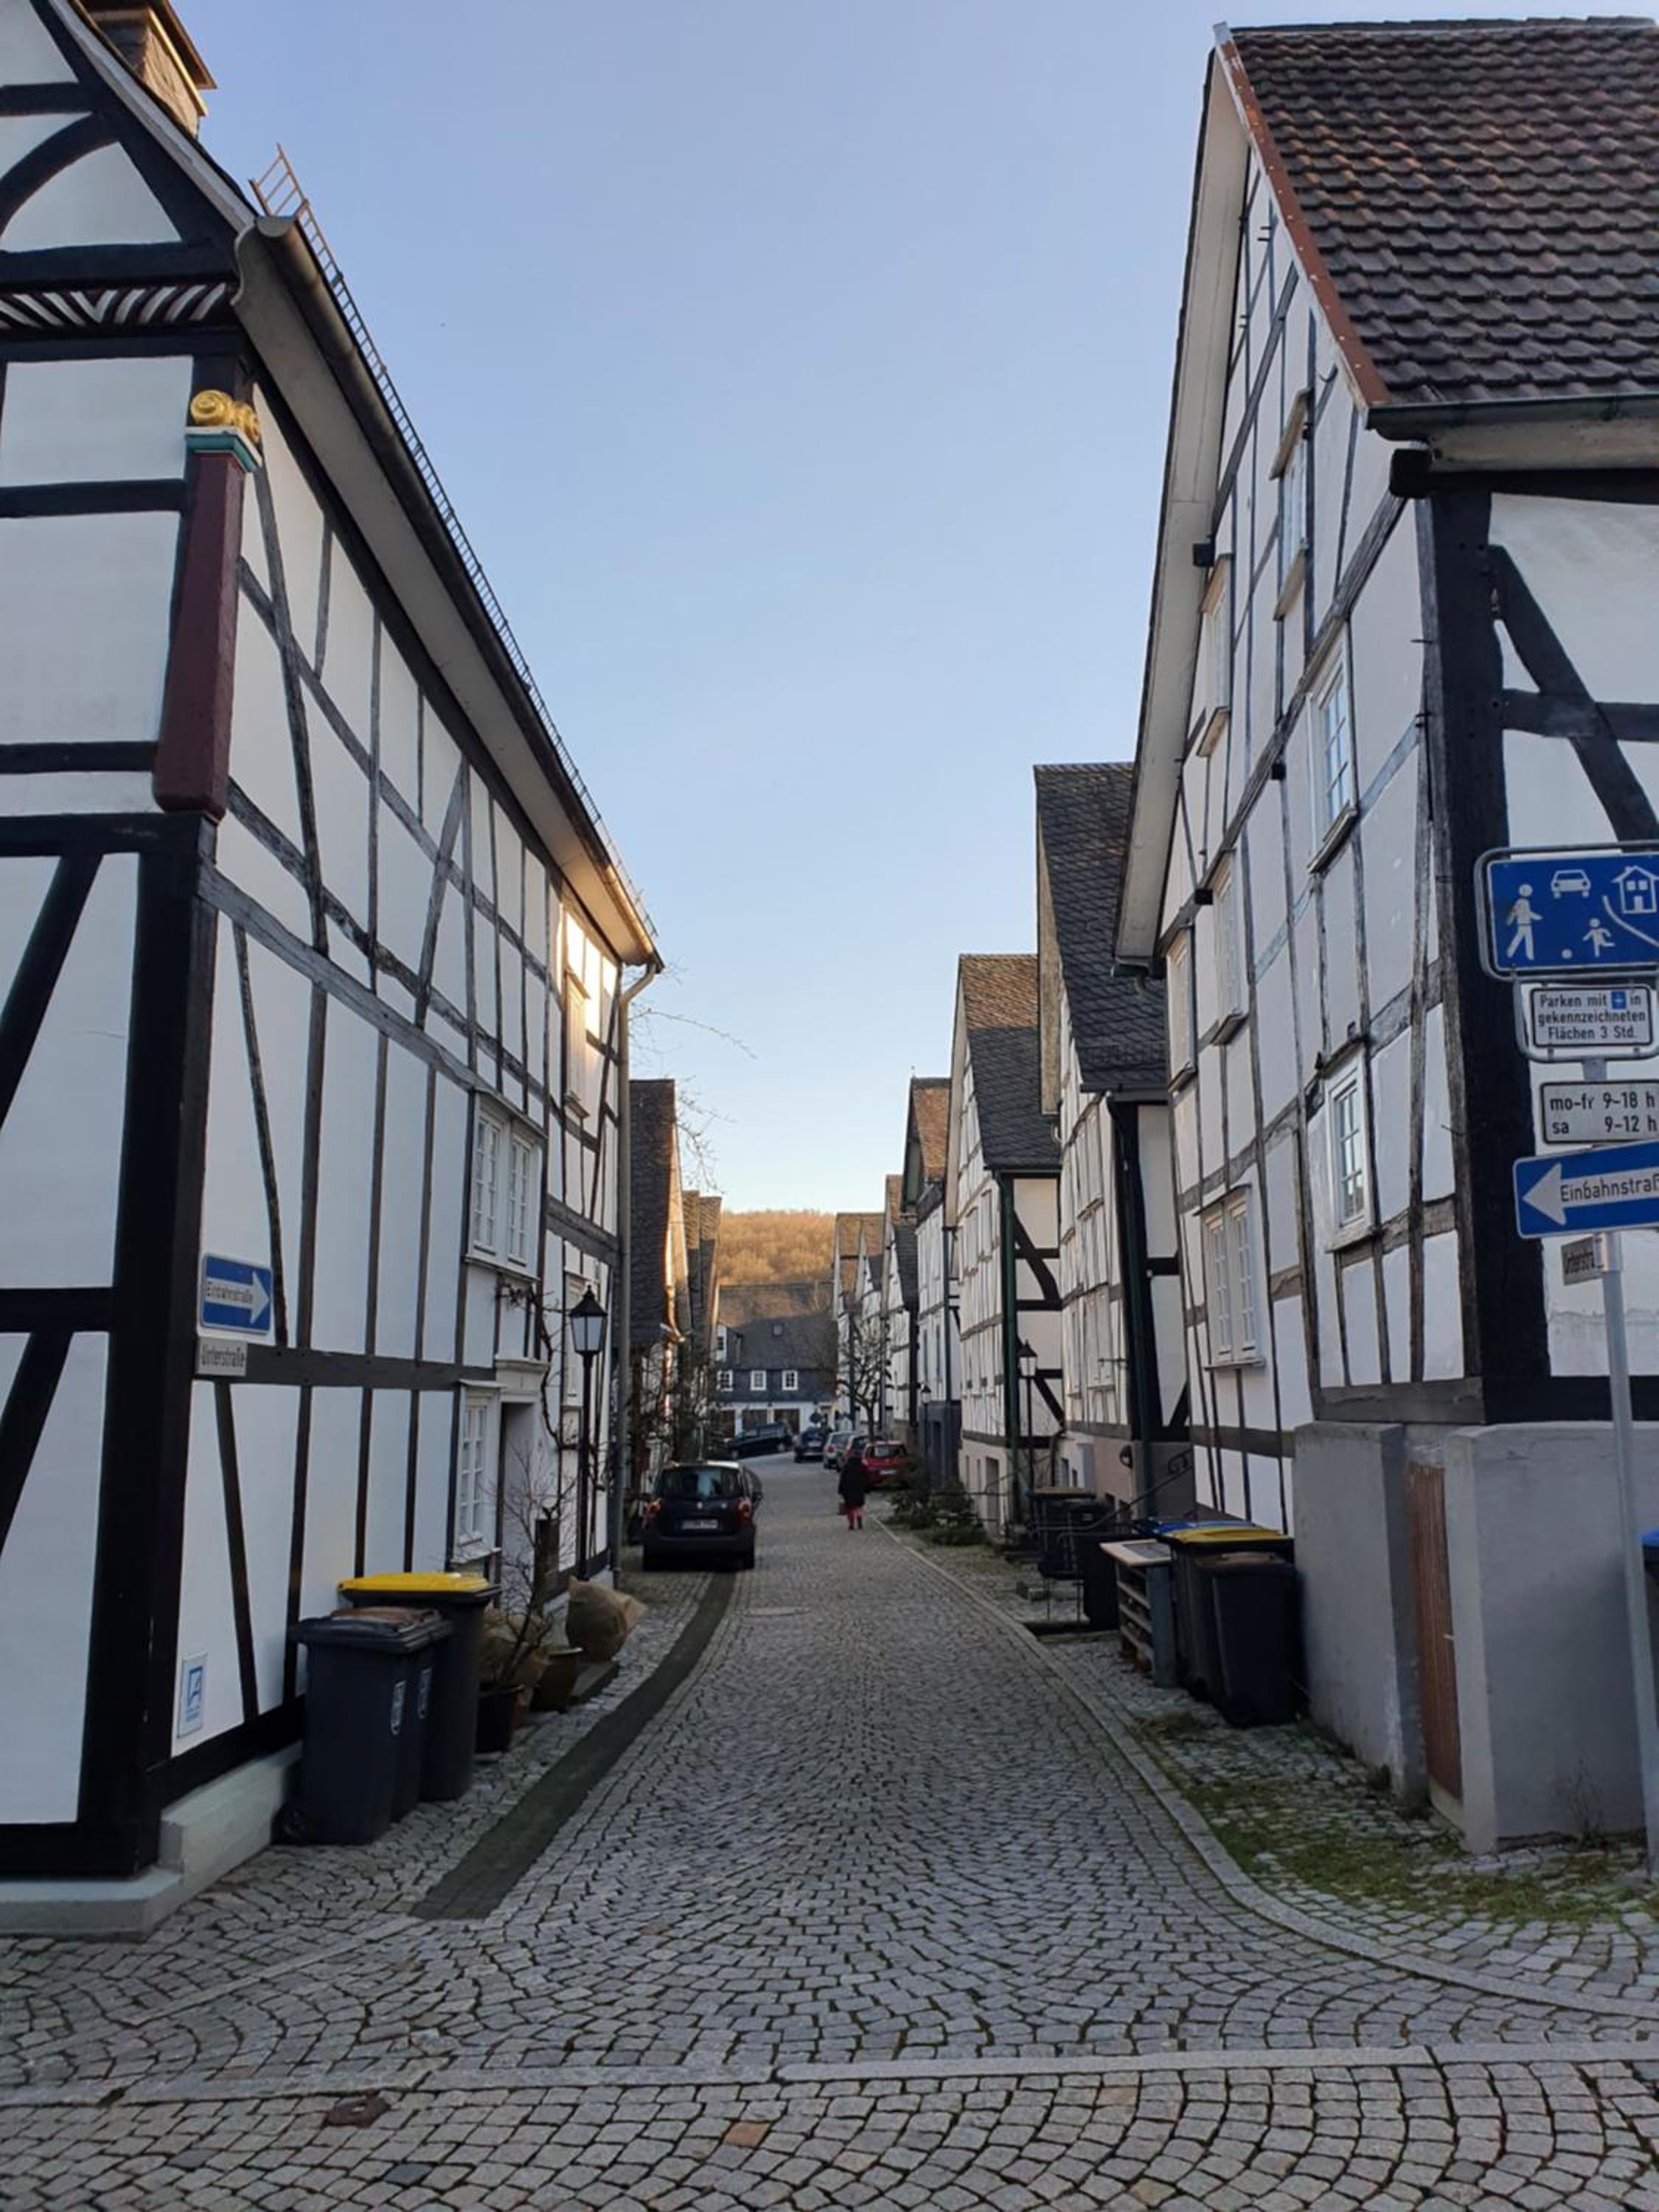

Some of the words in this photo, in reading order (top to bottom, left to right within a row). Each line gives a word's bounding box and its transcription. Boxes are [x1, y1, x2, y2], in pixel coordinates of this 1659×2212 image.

[1540, 994, 1582, 1008] Parken
[1587, 993, 1607, 1007] mit
[1630, 990, 1641, 1006] in
[1538, 1011, 1646, 1026] gekennzeichneten
[1549, 1026, 1595, 1040] Flächen
[1601, 1026, 1608, 1039] 3
[1550, 1093, 1594, 1110] mo-fr
[1603, 1091, 1638, 1108] 9-18
[1646, 1091, 1655, 1108] h
[1551, 1121, 1570, 1135] sa
[1604, 1115, 1640, 1133] 9-12
[1647, 1114, 1658, 1132] h
